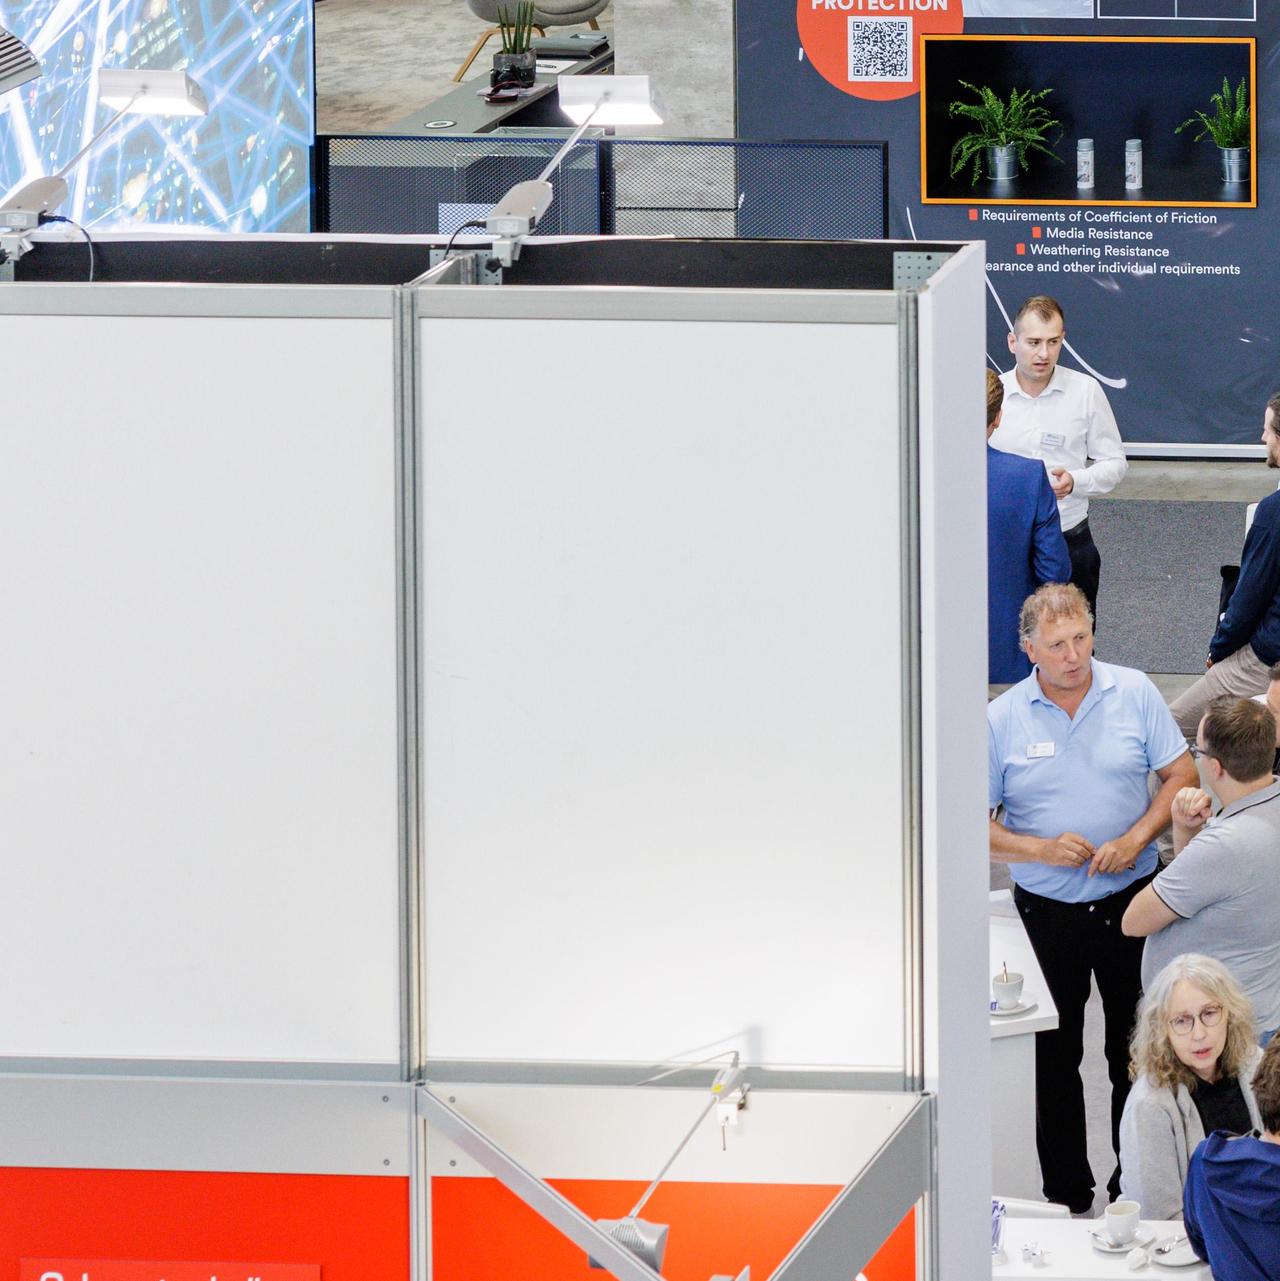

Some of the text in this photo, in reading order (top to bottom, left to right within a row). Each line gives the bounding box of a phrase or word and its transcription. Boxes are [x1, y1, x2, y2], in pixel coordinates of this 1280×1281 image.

[982, 209, 1217, 225] Requirements of Coefficient of Friction
[1046, 227, 1153, 241] Media Resistance
[1030, 243, 1170, 258] Weathering Resistance
[1037, 260, 1060, 273] and
[1062, 261, 1095, 273] other
[1098, 261, 1157, 275] individual
[1160, 263, 1241, 277] requirements
